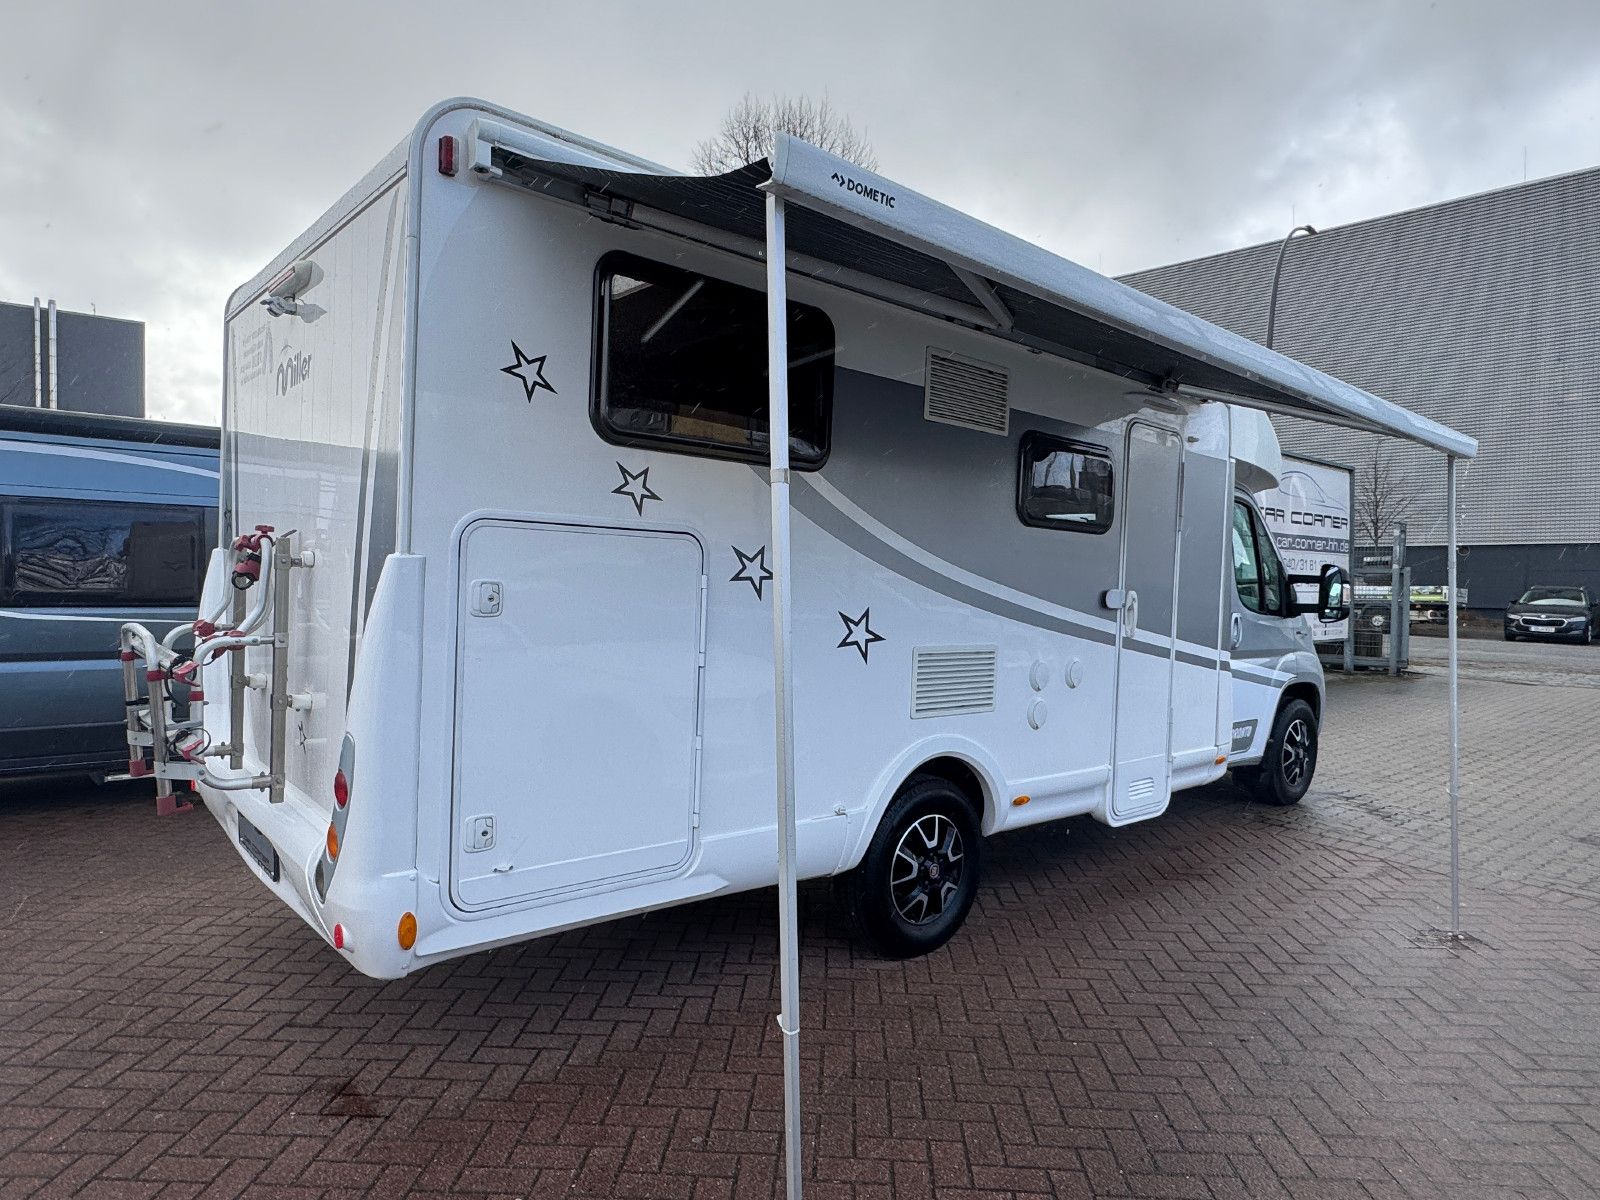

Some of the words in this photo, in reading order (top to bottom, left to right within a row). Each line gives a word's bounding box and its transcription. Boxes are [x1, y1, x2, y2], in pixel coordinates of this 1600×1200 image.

[846, 178, 896, 208] DOMETIC
[1260, 507, 1285, 523] AR
[1291, 512, 1348, 530] CORNER
